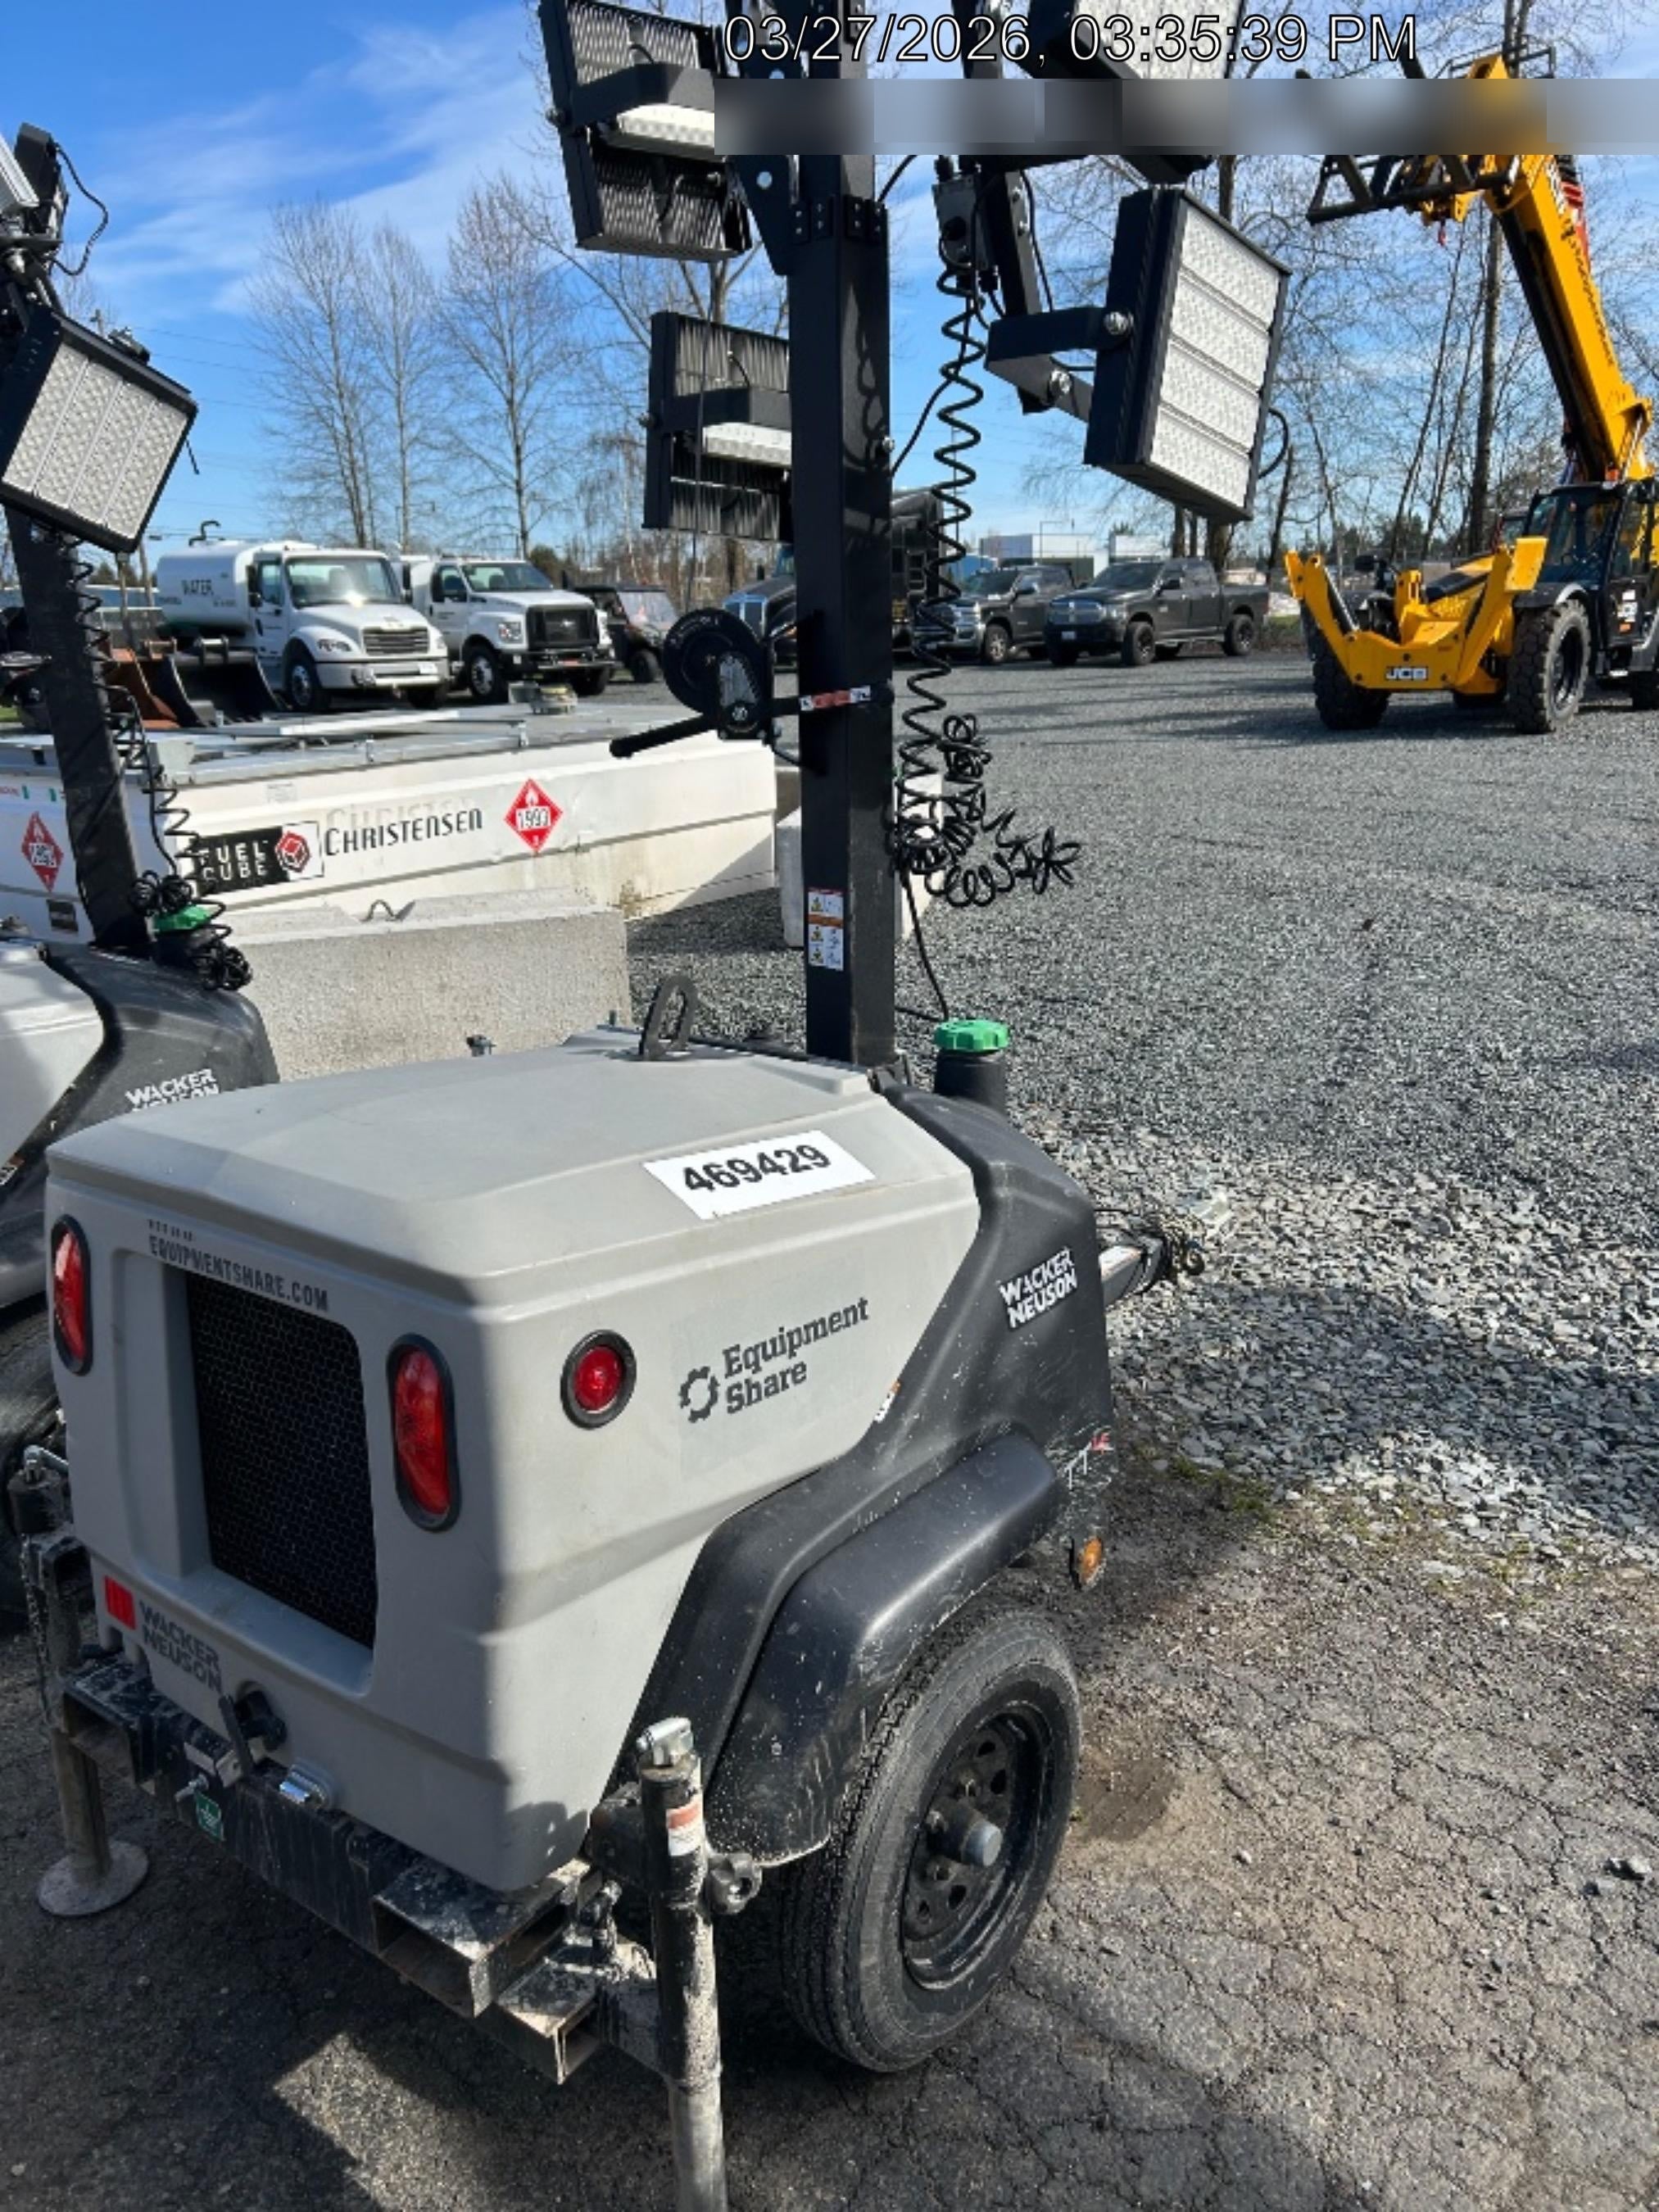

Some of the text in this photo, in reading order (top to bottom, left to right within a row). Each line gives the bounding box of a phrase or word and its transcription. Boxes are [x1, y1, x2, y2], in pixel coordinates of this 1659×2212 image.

[197, 841, 266, 866] FUEL
[324, 807, 483, 856] CHRISTENSEN
[202, 860, 268, 882] CUBE
[125, 1067, 216, 1105] WACKER
[682, 1144, 832, 1192] 469429
[148, 1234, 329, 1312] EQUIPMENTSHARE.COM
[999, 1247, 1075, 1306] WACKER
[1007, 1267, 1078, 1329] NEUSON
[722, 1296, 869, 1380] Equipment
[725, 1360, 807, 1415] Share
[139, 1599, 220, 1664] WACKER
[143, 1624, 223, 1695] NEUSON
